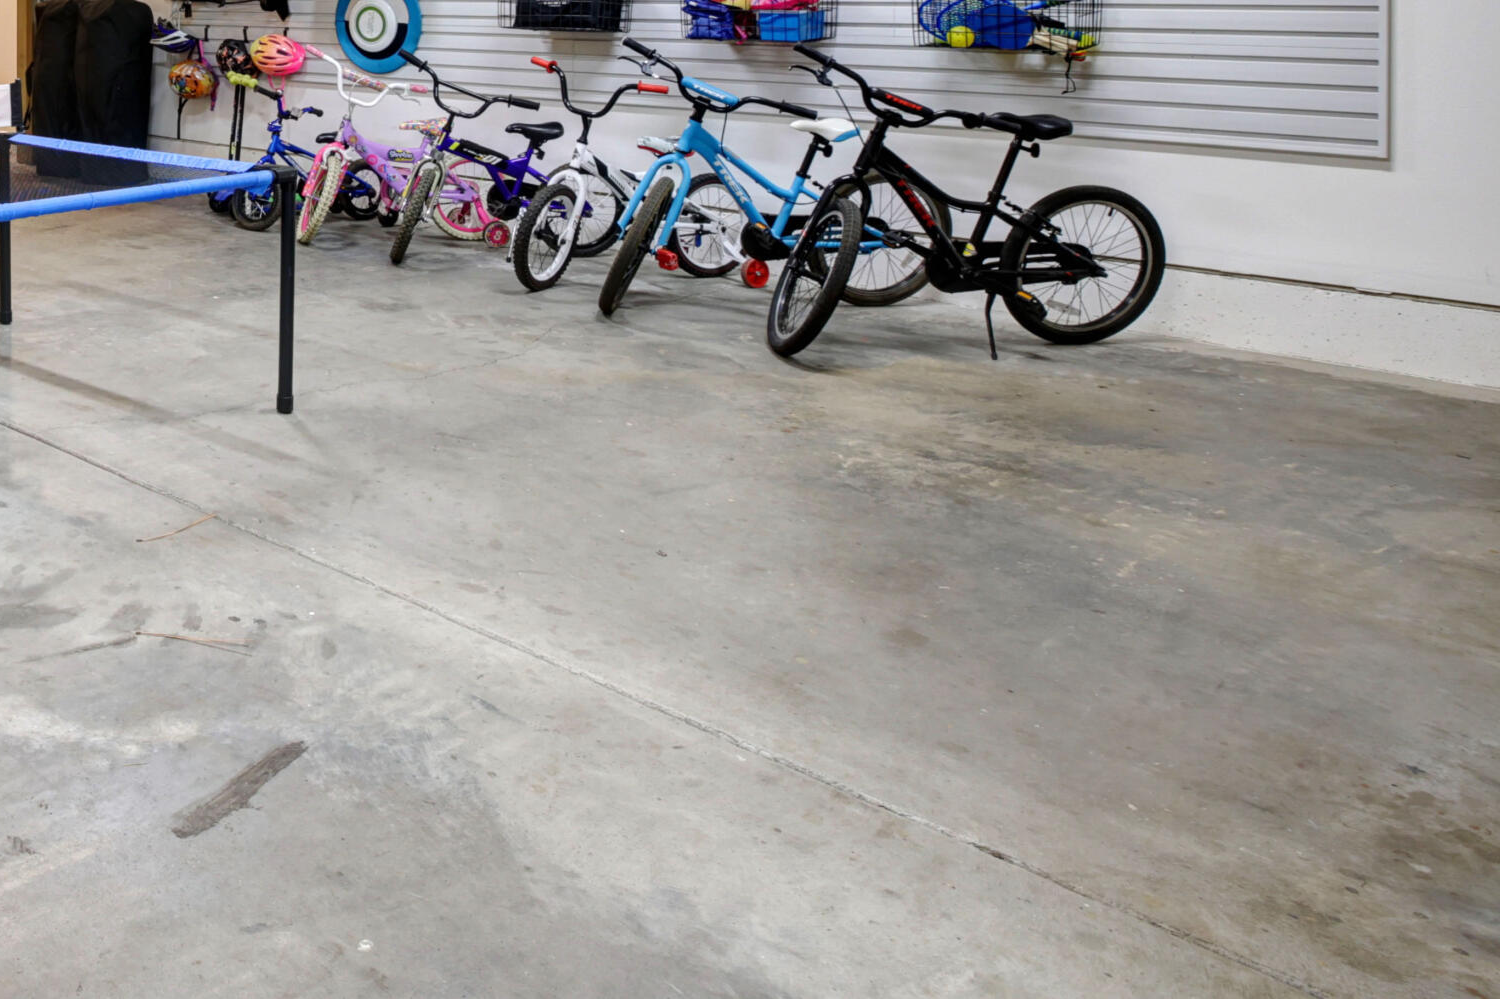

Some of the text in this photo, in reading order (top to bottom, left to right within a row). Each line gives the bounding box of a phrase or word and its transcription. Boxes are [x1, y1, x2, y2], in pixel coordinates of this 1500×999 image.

[885, 93, 923, 111] TREK
[714, 159, 748, 204] TREK
[897, 179, 936, 228] TREK
